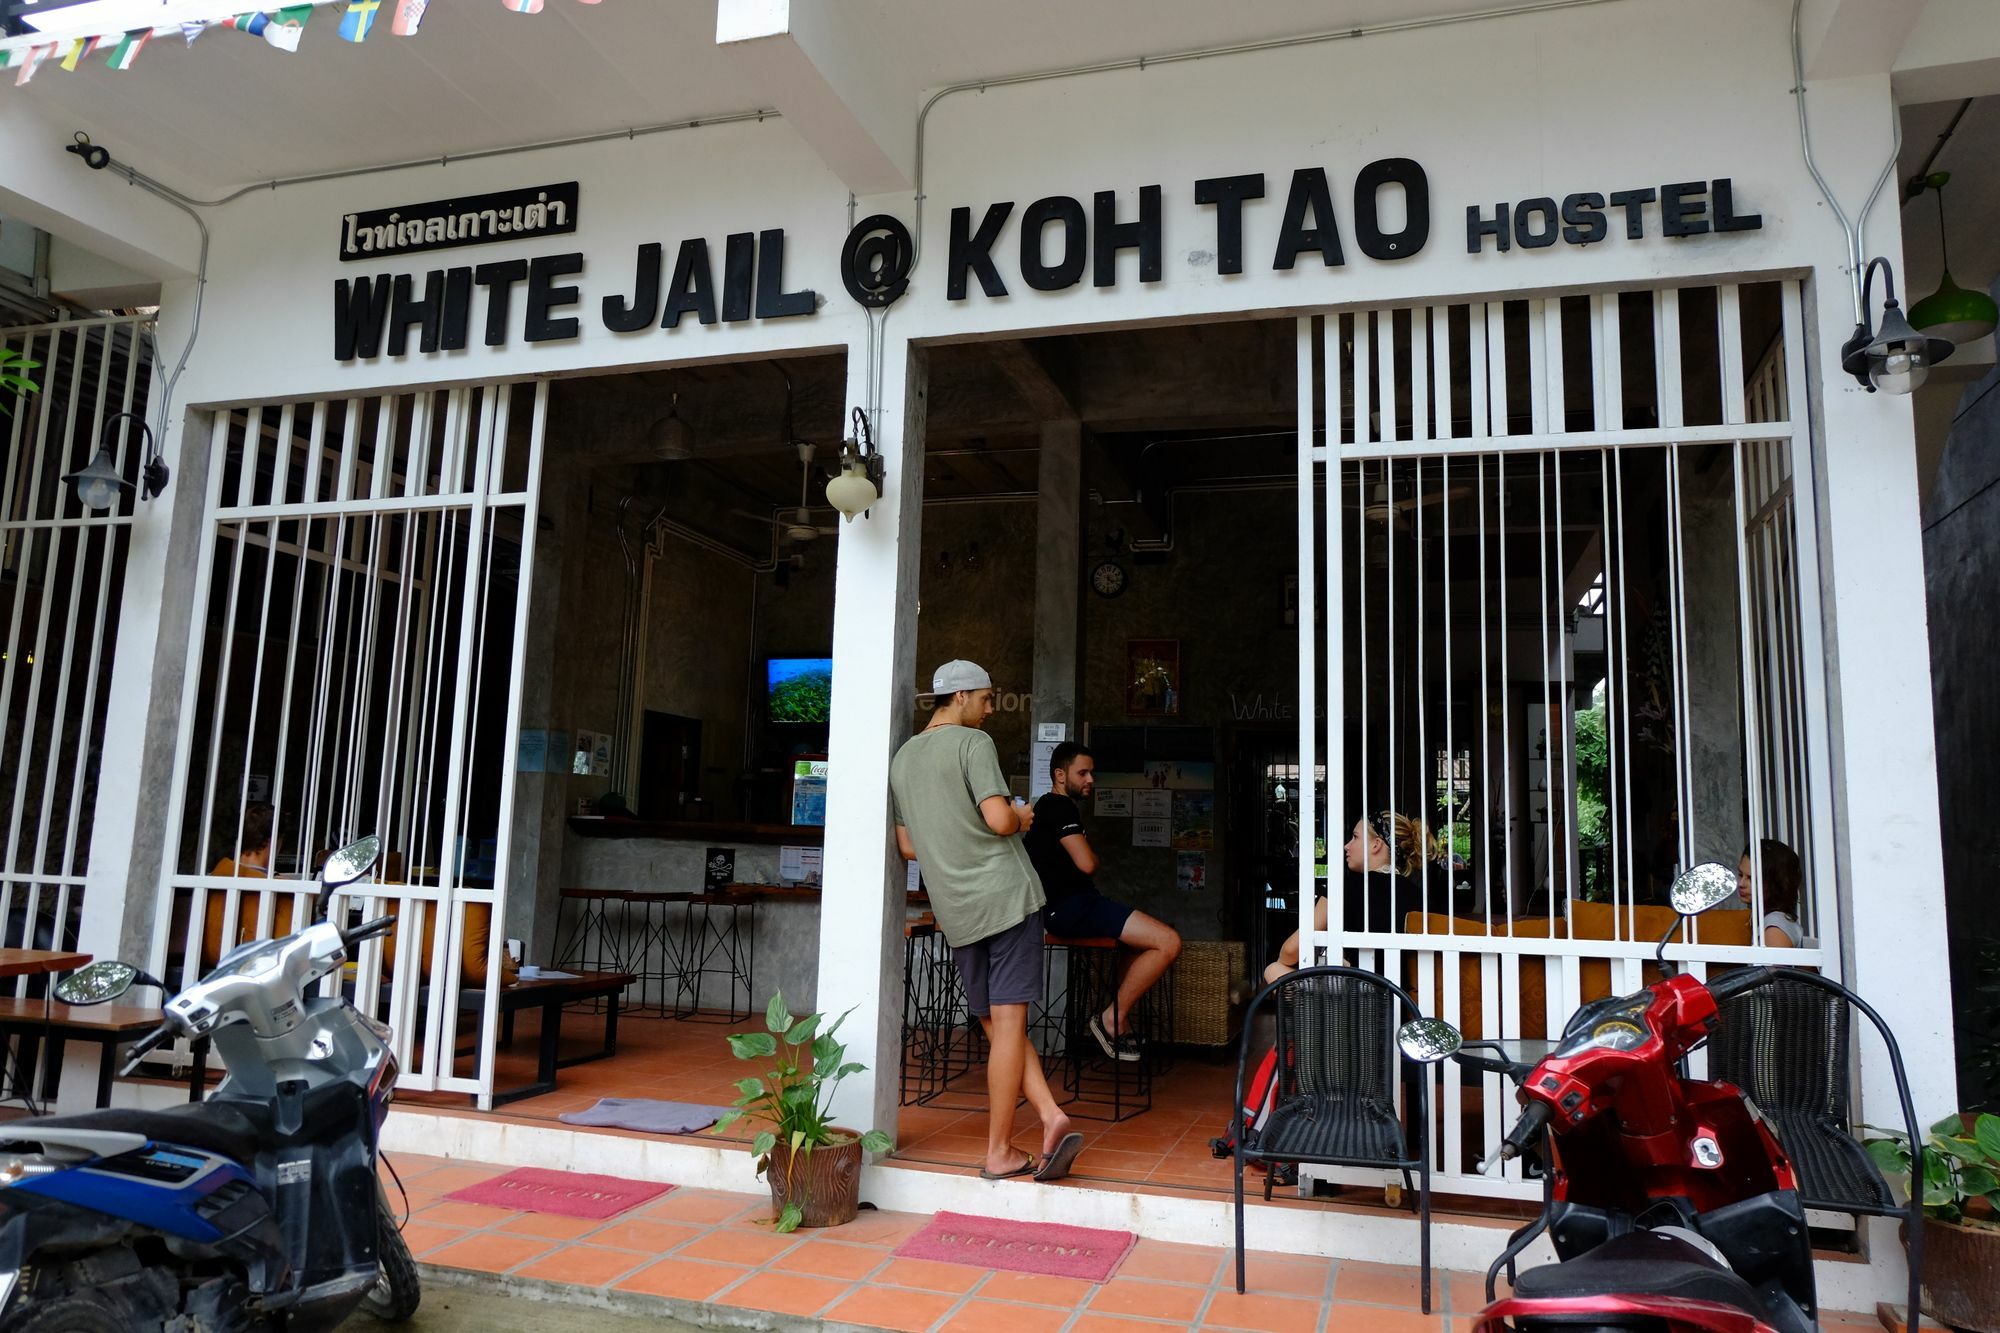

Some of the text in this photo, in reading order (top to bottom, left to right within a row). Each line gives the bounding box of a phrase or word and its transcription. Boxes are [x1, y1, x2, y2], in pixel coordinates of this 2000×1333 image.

[335, 157, 1763, 362] WHITE JAIL @ KOH TAO HOSTEL
[345, 191, 567, 254] ไวท์เจลเกาะเต่า
